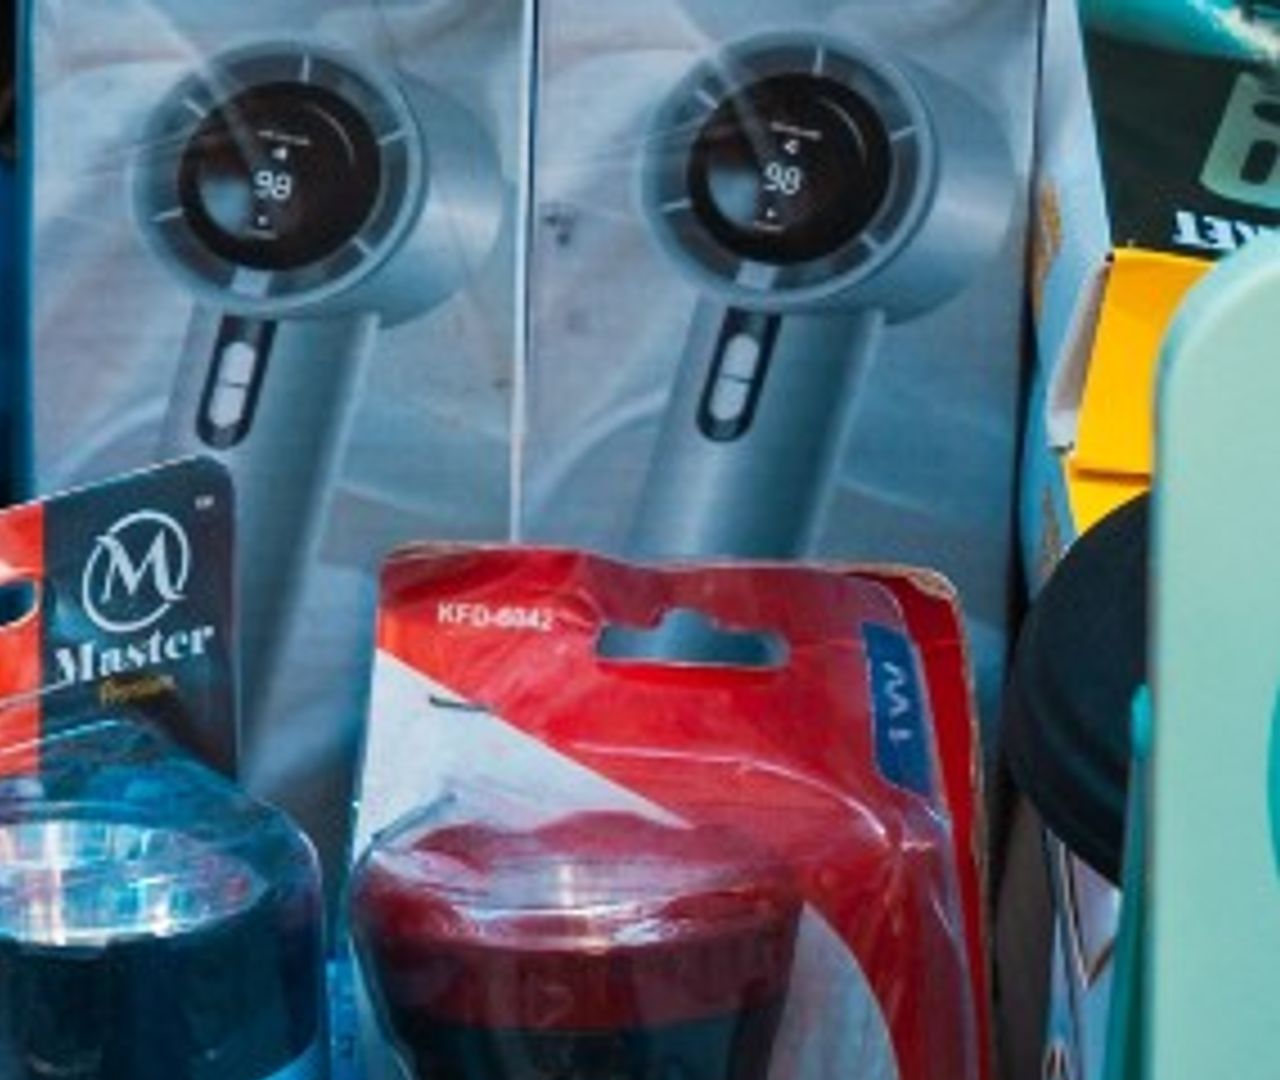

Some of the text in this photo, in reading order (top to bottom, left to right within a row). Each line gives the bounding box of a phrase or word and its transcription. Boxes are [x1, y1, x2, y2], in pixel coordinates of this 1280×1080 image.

[254, 170, 291, 200] 98
[764, 162, 800, 195] 98
[46, 625, 215, 688] Master
